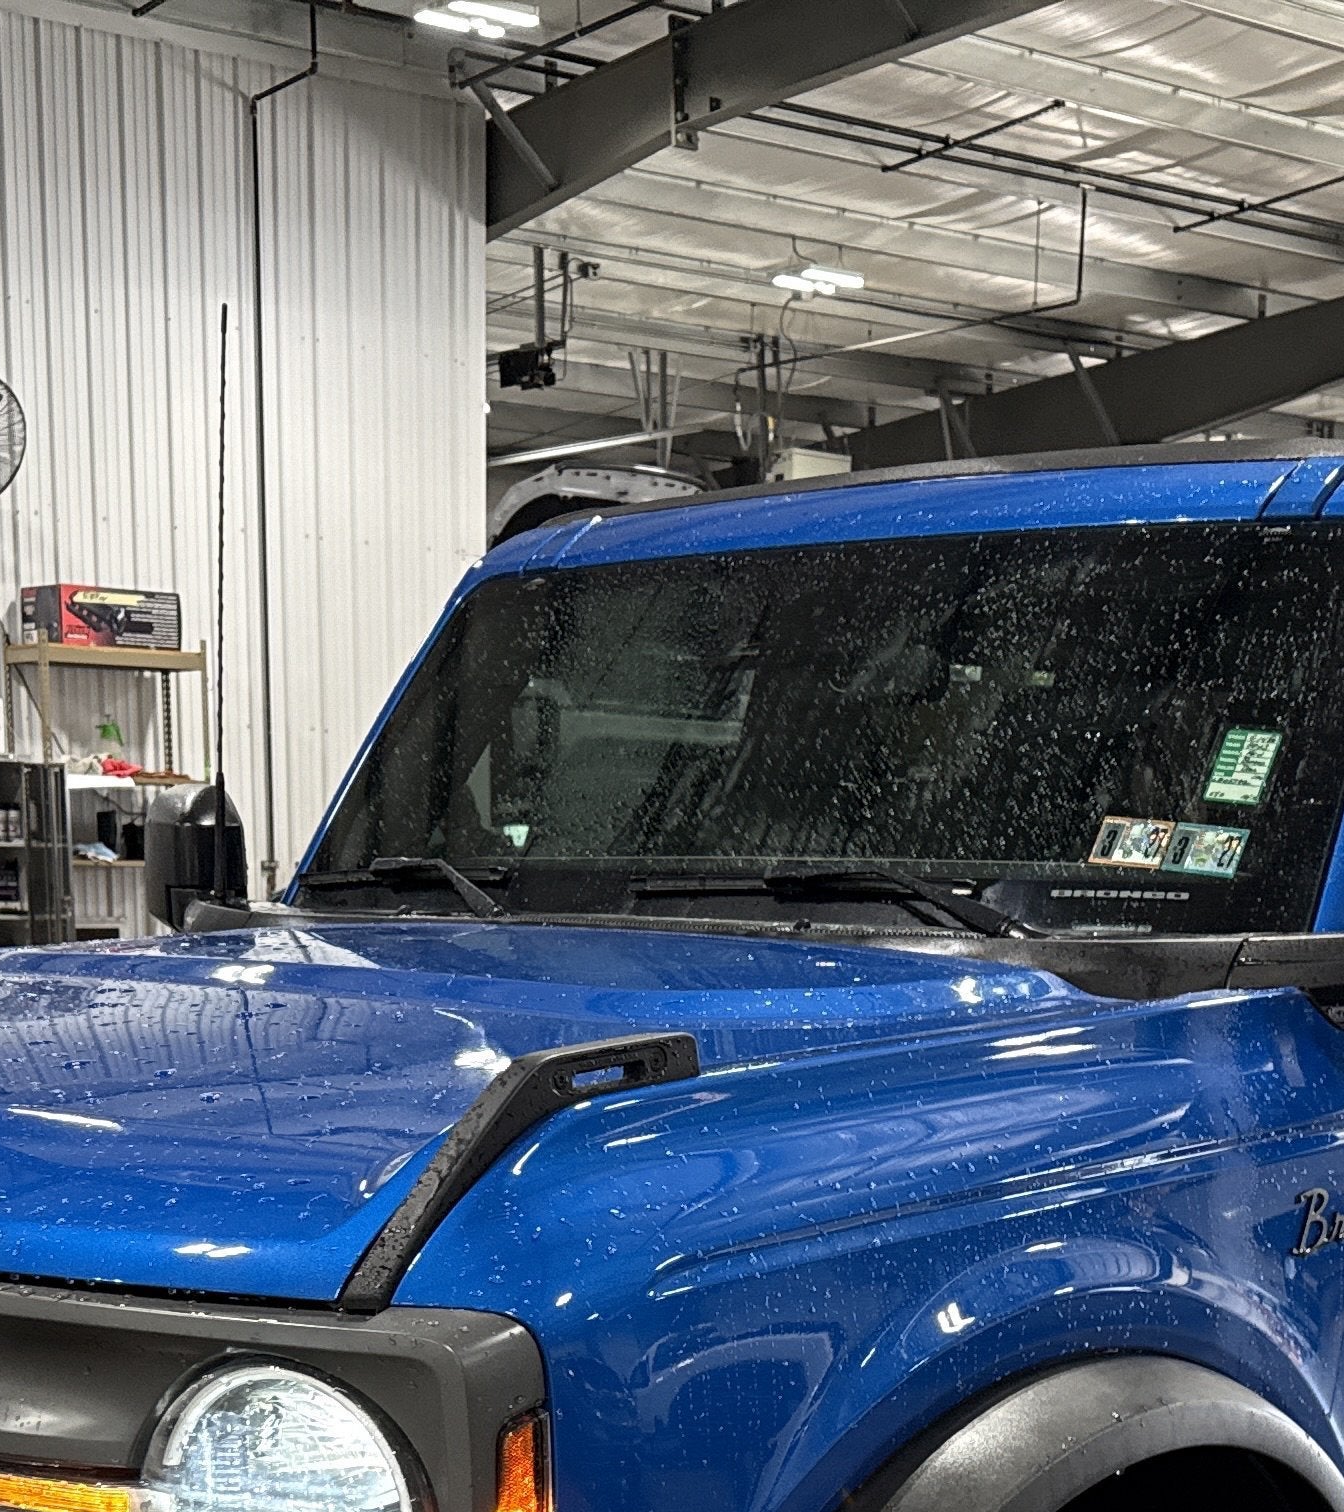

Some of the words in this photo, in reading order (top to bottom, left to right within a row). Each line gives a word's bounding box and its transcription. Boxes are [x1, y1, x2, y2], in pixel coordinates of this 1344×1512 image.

[1100, 829, 1119, 857] 3
[1171, 836, 1191, 865] 3
[1217, 835, 1243, 869] 27
[1050, 889, 1190, 901] BRONCO
